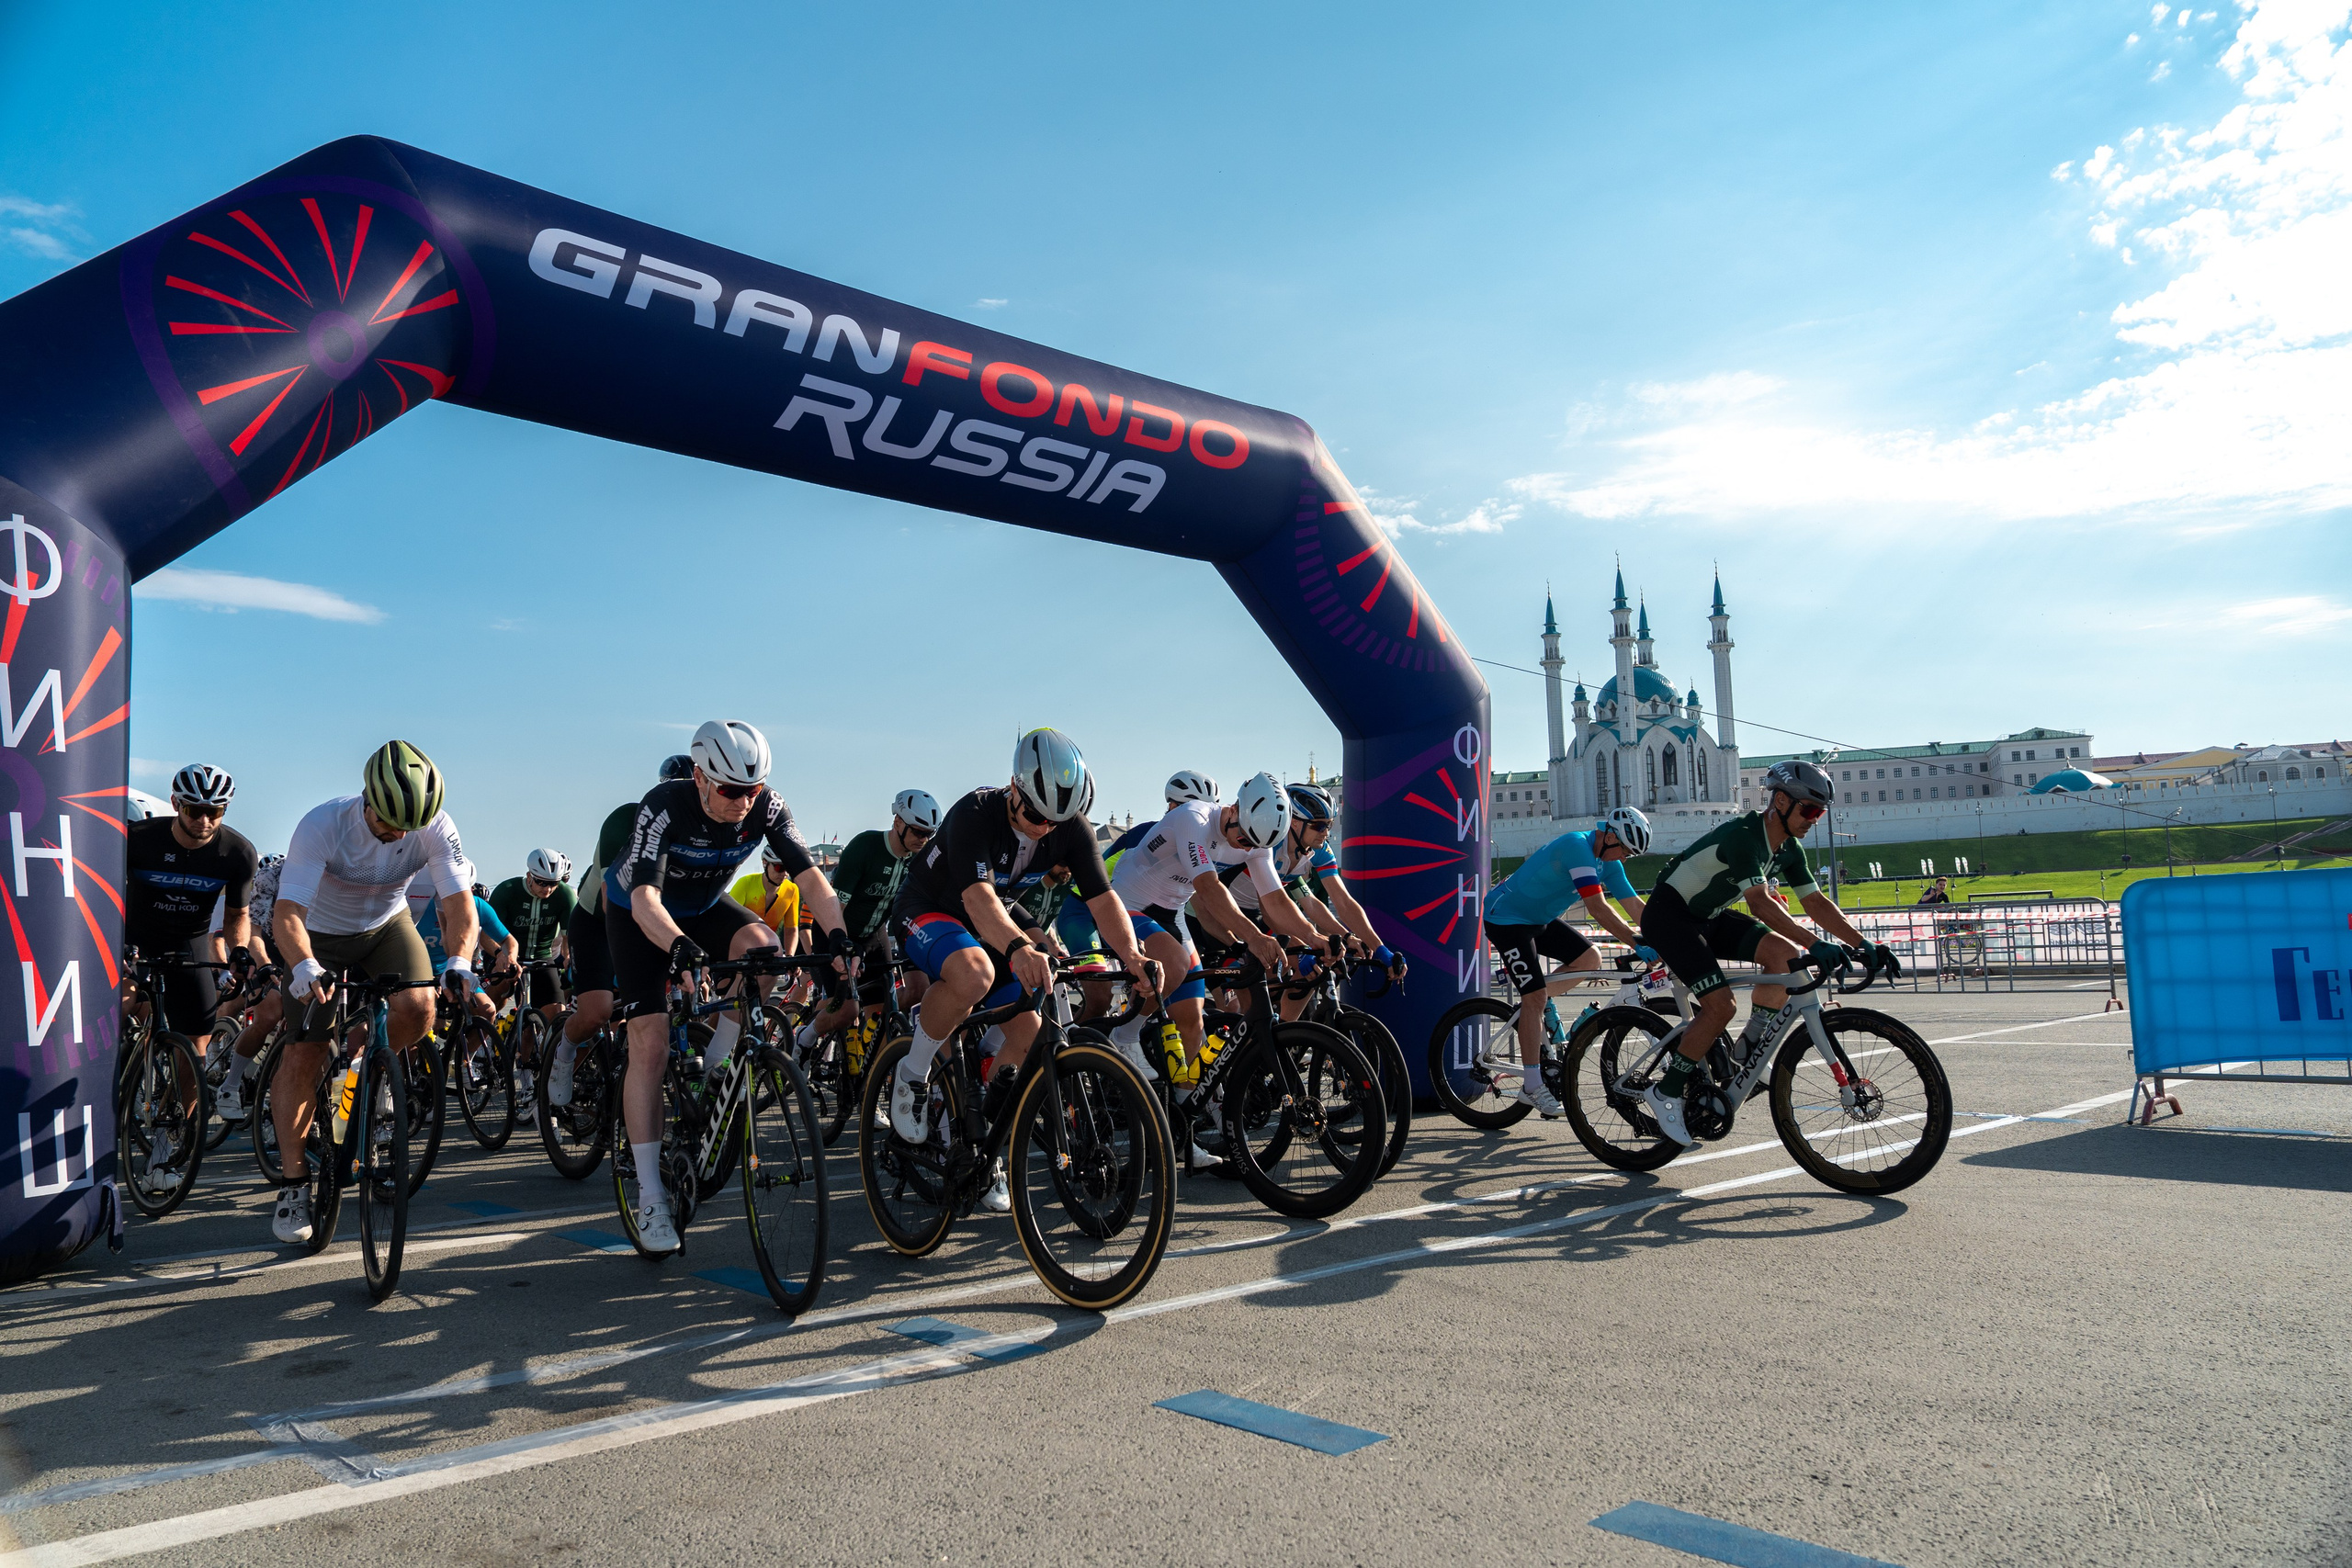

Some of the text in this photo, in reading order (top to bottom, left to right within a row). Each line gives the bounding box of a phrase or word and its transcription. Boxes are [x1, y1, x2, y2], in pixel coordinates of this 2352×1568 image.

[774, 374, 1167, 513] RUSSIA
[630, 805, 654, 863] Andrey
[669, 845, 717, 858] ZUBOV
[976, 861, 988, 879] FIZIK
[1188, 841, 1200, 868] MATVEY
[1197, 844, 1209, 864] ZUBOV
[149, 874, 217, 888] ZUBOV
[901, 916, 933, 944] ZUBOV
[1504, 947, 1534, 989] RCA
[1191, 1021, 1248, 1106] PINARELLO
[1734, 1003, 1792, 1090] PINARELLO
[1226, 1120, 1250, 1175] DT SWISS
